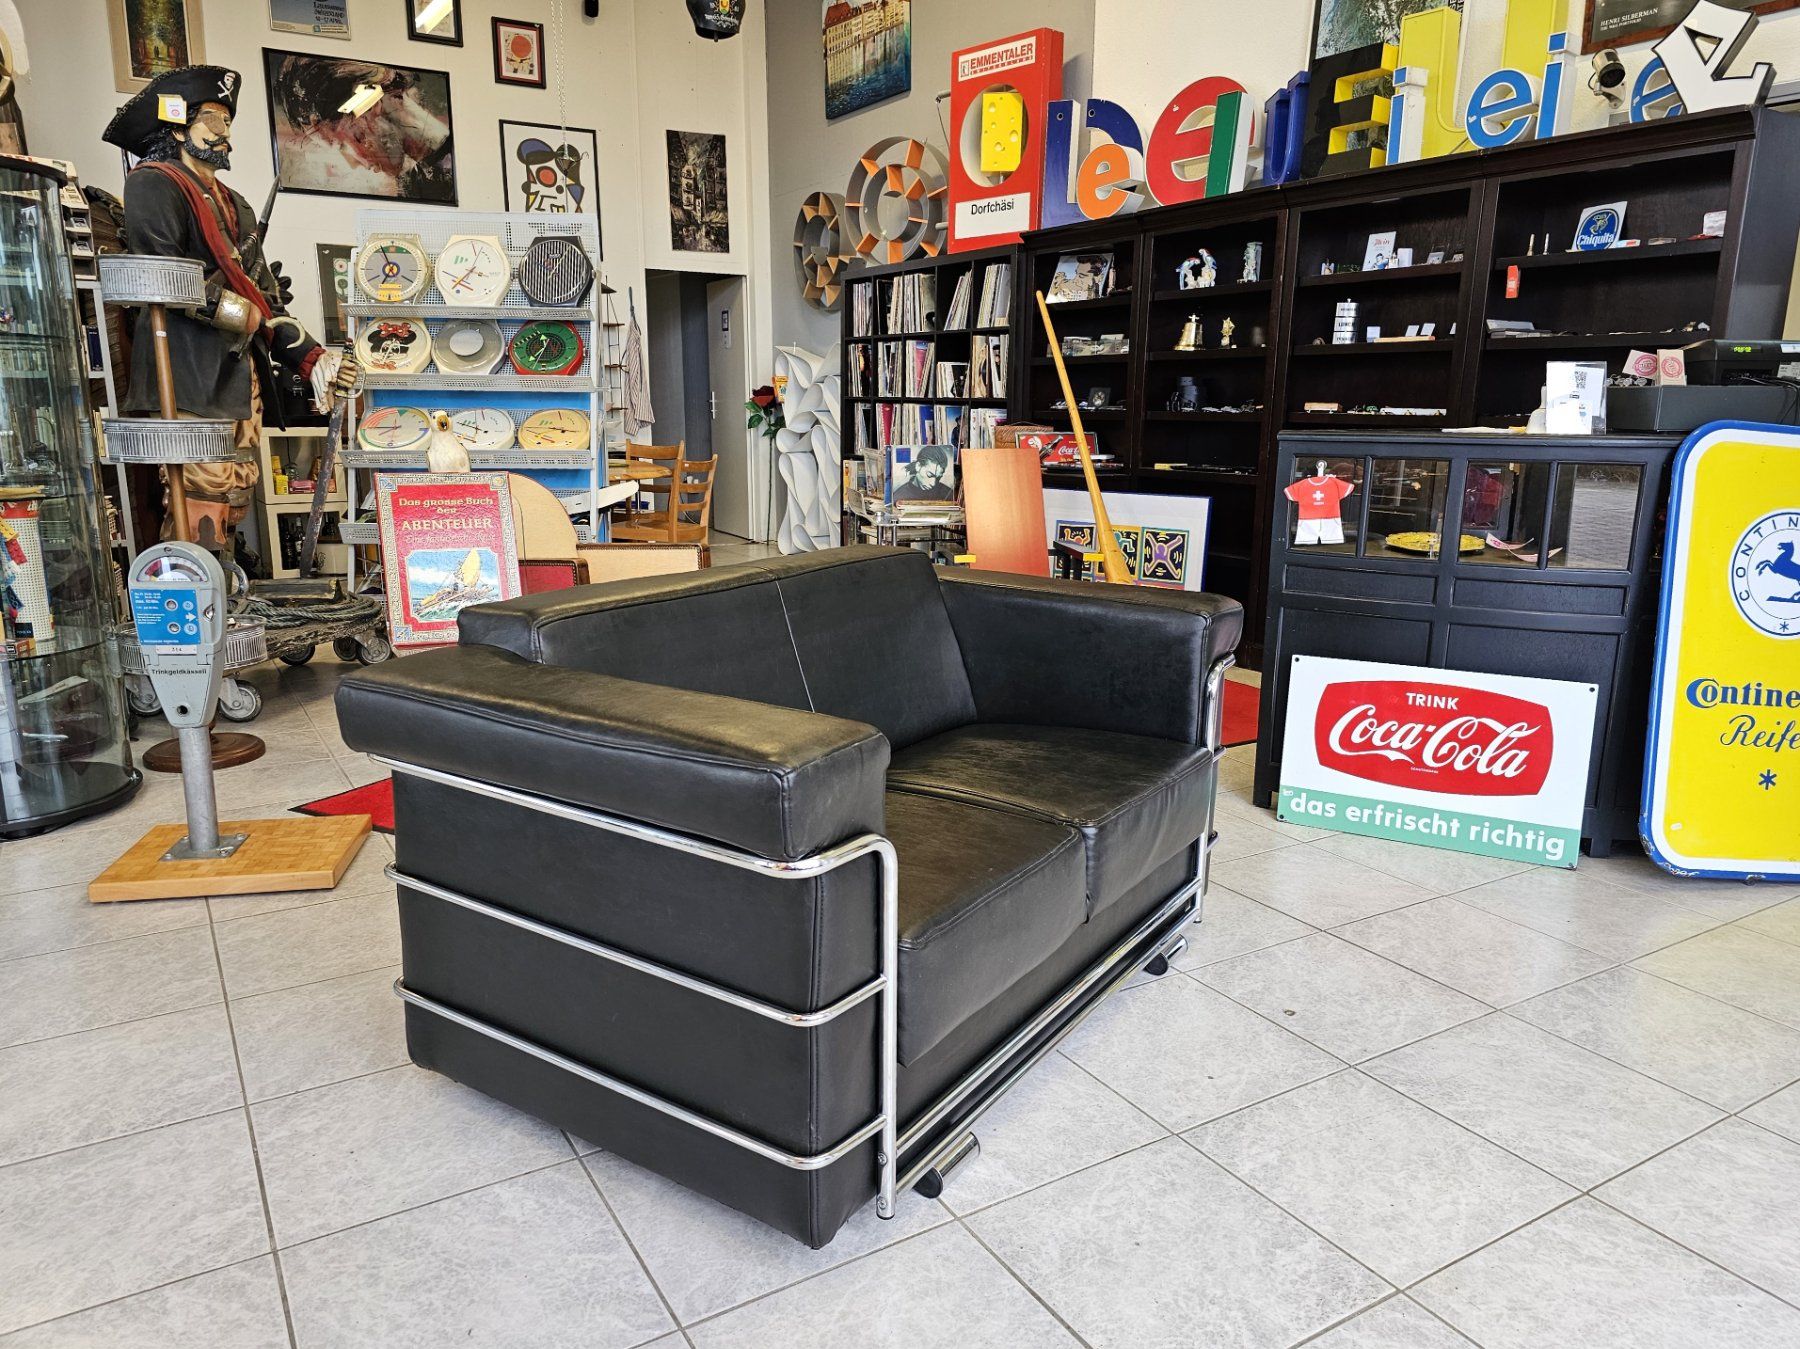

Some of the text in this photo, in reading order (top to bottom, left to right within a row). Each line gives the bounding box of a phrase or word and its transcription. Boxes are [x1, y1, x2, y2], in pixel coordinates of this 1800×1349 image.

[1600, 17, 1621, 27] HENRI
[1621, 7, 1659, 22] SILBERMAN
[970, 43, 1033, 70] EMMENTALER
[971, 198, 1015, 215] Dorfchäsi
[1576, 232, 1615, 248] Chiquita
[398, 497, 494, 508] Das grosse Buch
[401, 518, 494, 531] ABENTEUER
[1405, 692, 1460, 710] TRINK
[1328, 703, 1542, 778] Coca-Cola
[1290, 792, 1566, 861] das erfrischt richtig
